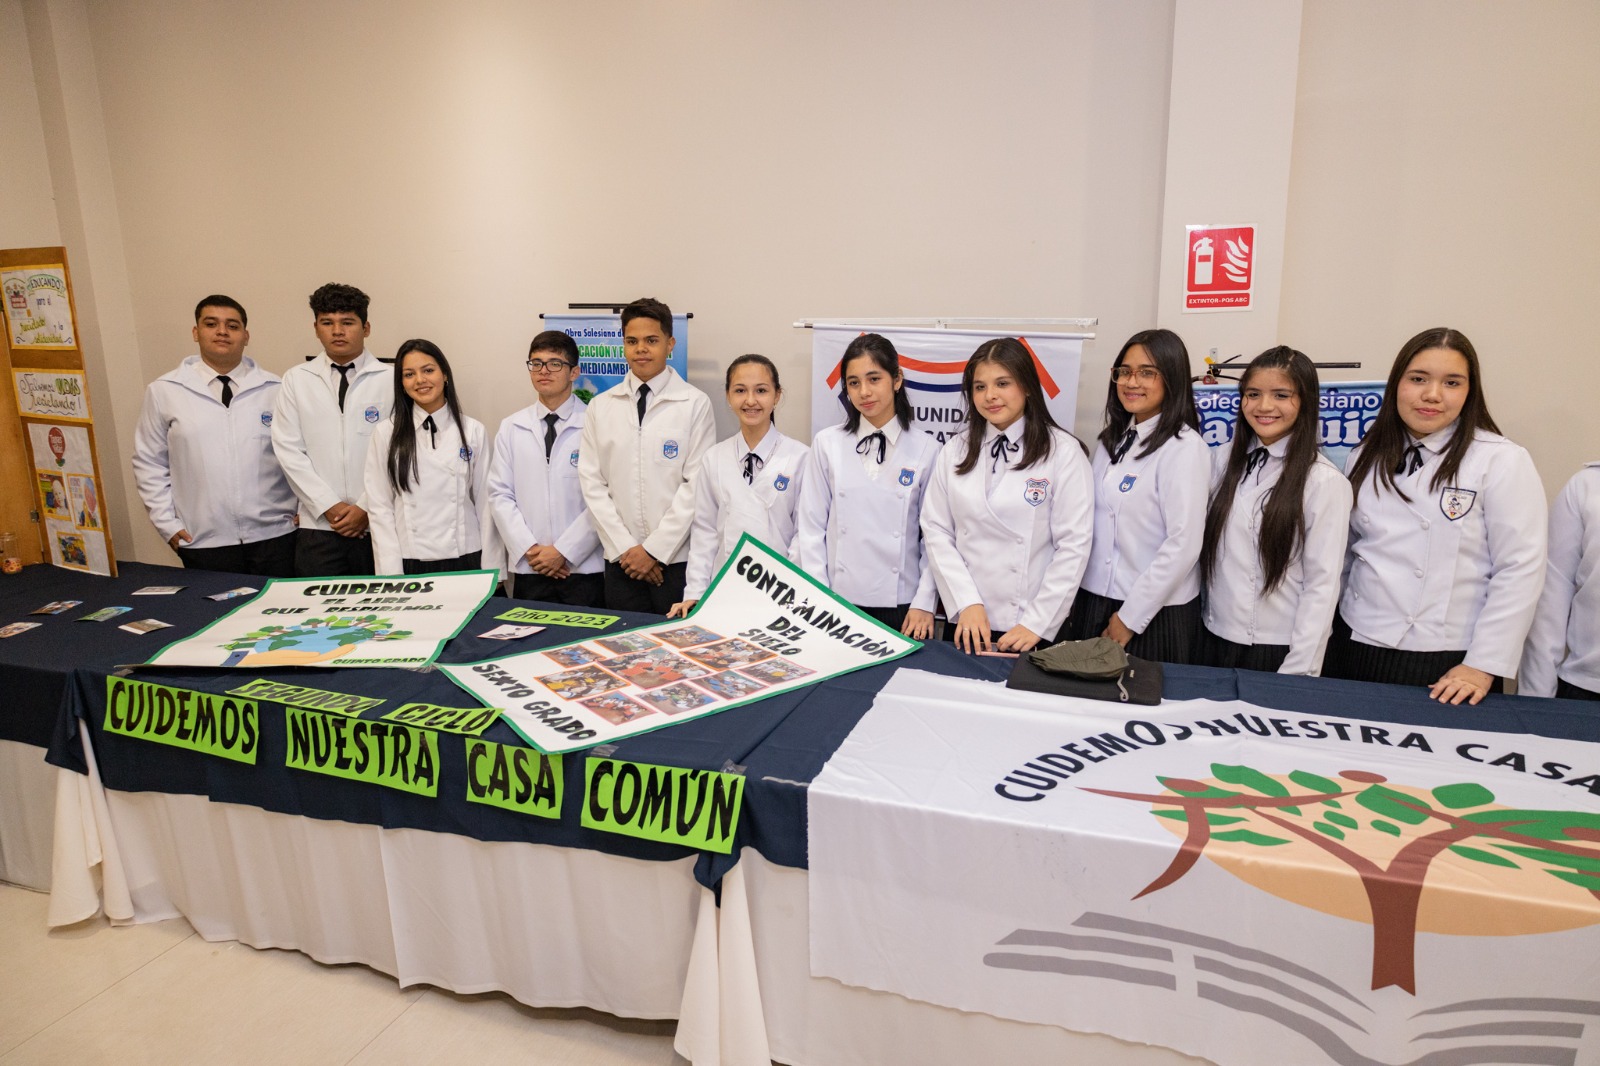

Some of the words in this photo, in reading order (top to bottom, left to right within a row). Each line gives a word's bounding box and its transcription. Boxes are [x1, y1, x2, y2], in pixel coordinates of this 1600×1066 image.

[565, 328, 582, 338] Obra
[584, 328, 616, 338] Salesiana
[579, 344, 611, 359] CACIÓN
[612, 346, 618, 359] Y
[580, 362, 629, 376] MEDIOAMBI
[1318, 390, 1379, 409] siano
[303, 581, 434, 596] CUIDEMOS
[261, 607, 310, 615] QUE
[323, 604, 443, 613] RESPIRAMOS
[358, 597, 411, 605] AIRE
[736, 555, 895, 658] CONTAMINACIÓN
[506, 610, 549, 621] Año
[551, 614, 613, 626] 2023
[766, 616, 808, 641] DEL
[738, 628, 802, 656] SUELO
[333, 657, 381, 665] QUINTO
[241, 682, 377, 714] SEGUNDO
[393, 704, 497, 732] CICLO
[472, 663, 535, 699] SEXTO
[523, 700, 597, 741] GRADO
[110, 681, 256, 755] CUIDEMOS
[290, 711, 434, 789] NUESTRA
[468, 742, 556, 810] CASA
[588, 760, 740, 843] COMÚN
[1455, 743, 1600, 797] CASA
